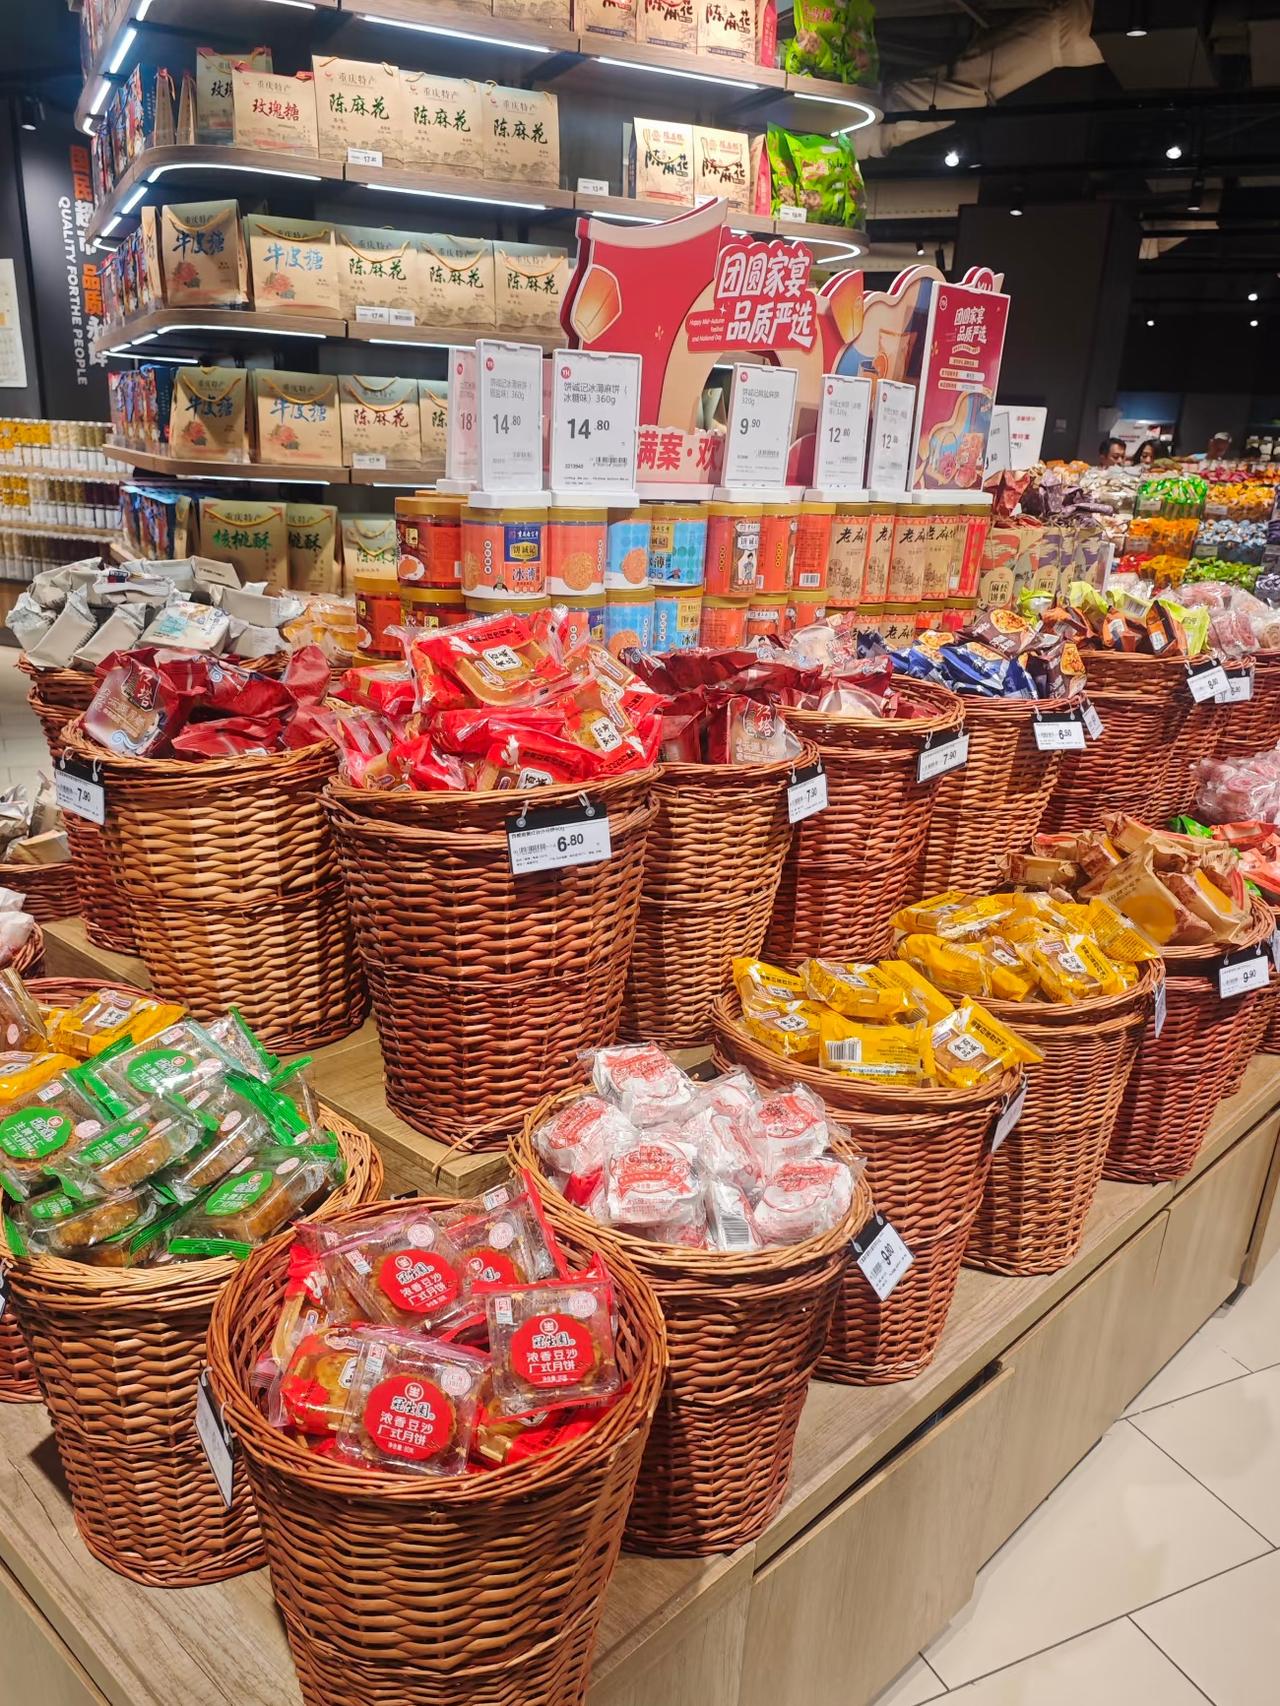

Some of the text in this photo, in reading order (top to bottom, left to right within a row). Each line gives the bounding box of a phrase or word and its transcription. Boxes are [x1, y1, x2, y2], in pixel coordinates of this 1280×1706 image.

[253, 98, 300, 121] 玫瑰糖
[329, 93, 390, 121] 陈麻花
[413, 105, 471, 133] 陈麻花
[494, 118, 548, 145] 陈麻花
[172, 230, 225, 260] 牛皮糖
[263, 242, 323, 272] 牛皮糖
[349, 257, 407, 281] 陈麻花
[429, 265, 485, 289] 陈麻花
[717, 248, 810, 299] 团圆家宴
[58, 195, 77, 264] QUALITY
[73, 328, 88, 386] PEOPLE
[507, 273, 559, 296] 陈麻花
[726, 300, 814, 349] 品质严选
[270, 400, 328, 423] 牛皮糖
[596, 395, 617, 406] 360g
[353, 409, 409, 428] 陈麻花
[212, 529, 271, 550] 核桃酥
[943, 750, 957, 765] 7.90
[557, 833, 584, 852] 6.80
[399, 1272, 442, 1298] 浓香豆沙
[408, 1281, 448, 1307] 广式月饼
[527, 1349, 578, 1363] 浓香豆沙
[529, 1360, 576, 1374] 广式月饼
[380, 1410, 433, 1435] 浓香豆沙
[377, 1425, 427, 1447] 广式月饼
